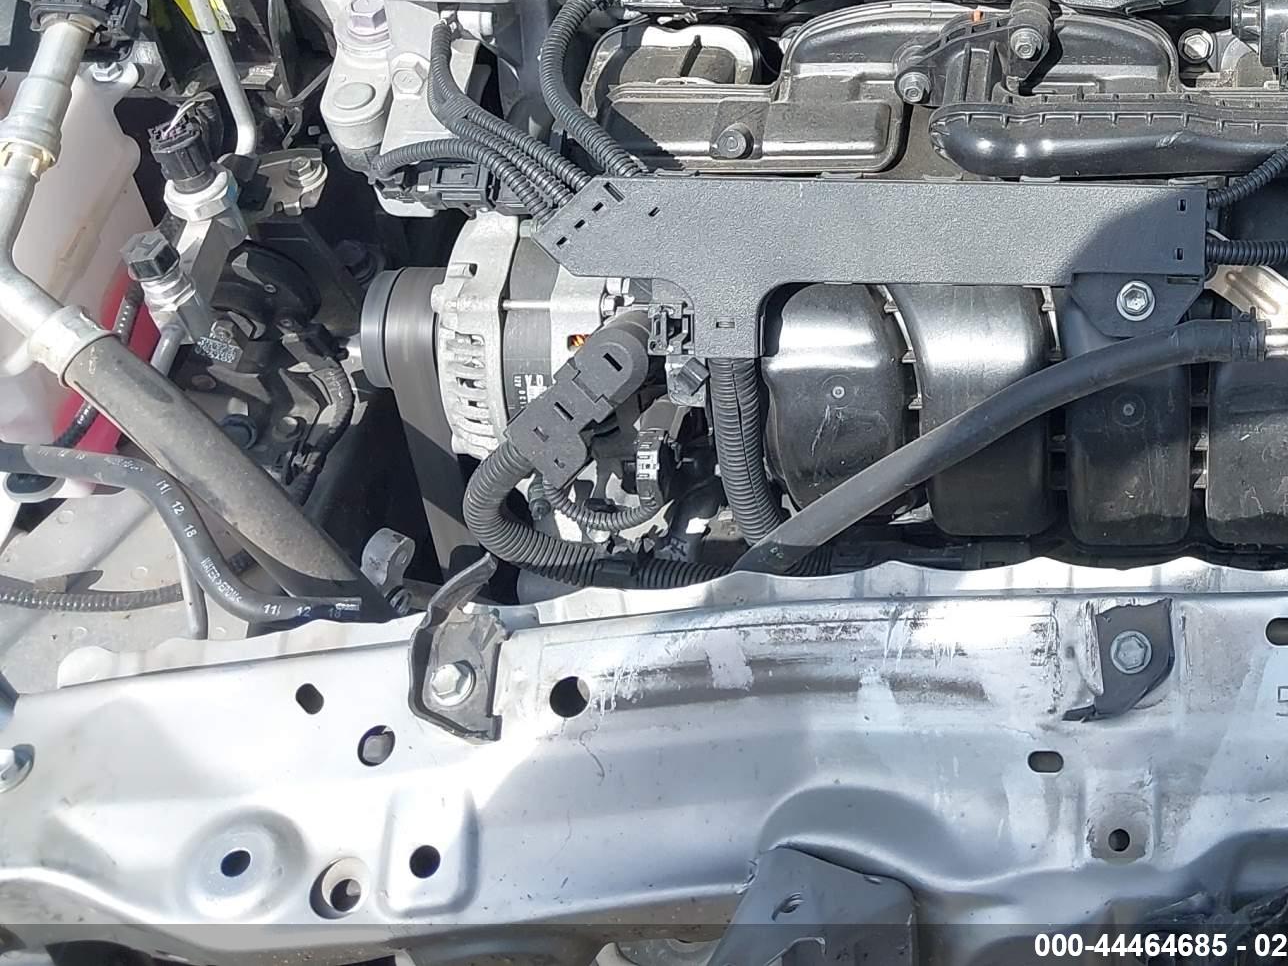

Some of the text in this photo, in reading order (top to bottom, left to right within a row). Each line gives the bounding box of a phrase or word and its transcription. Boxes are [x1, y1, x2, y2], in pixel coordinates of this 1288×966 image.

[172, 500, 185, 515] 12
[184, 524, 197, 538] 18
[296, 606, 311, 618] 12
[328, 608, 342, 619] 18
